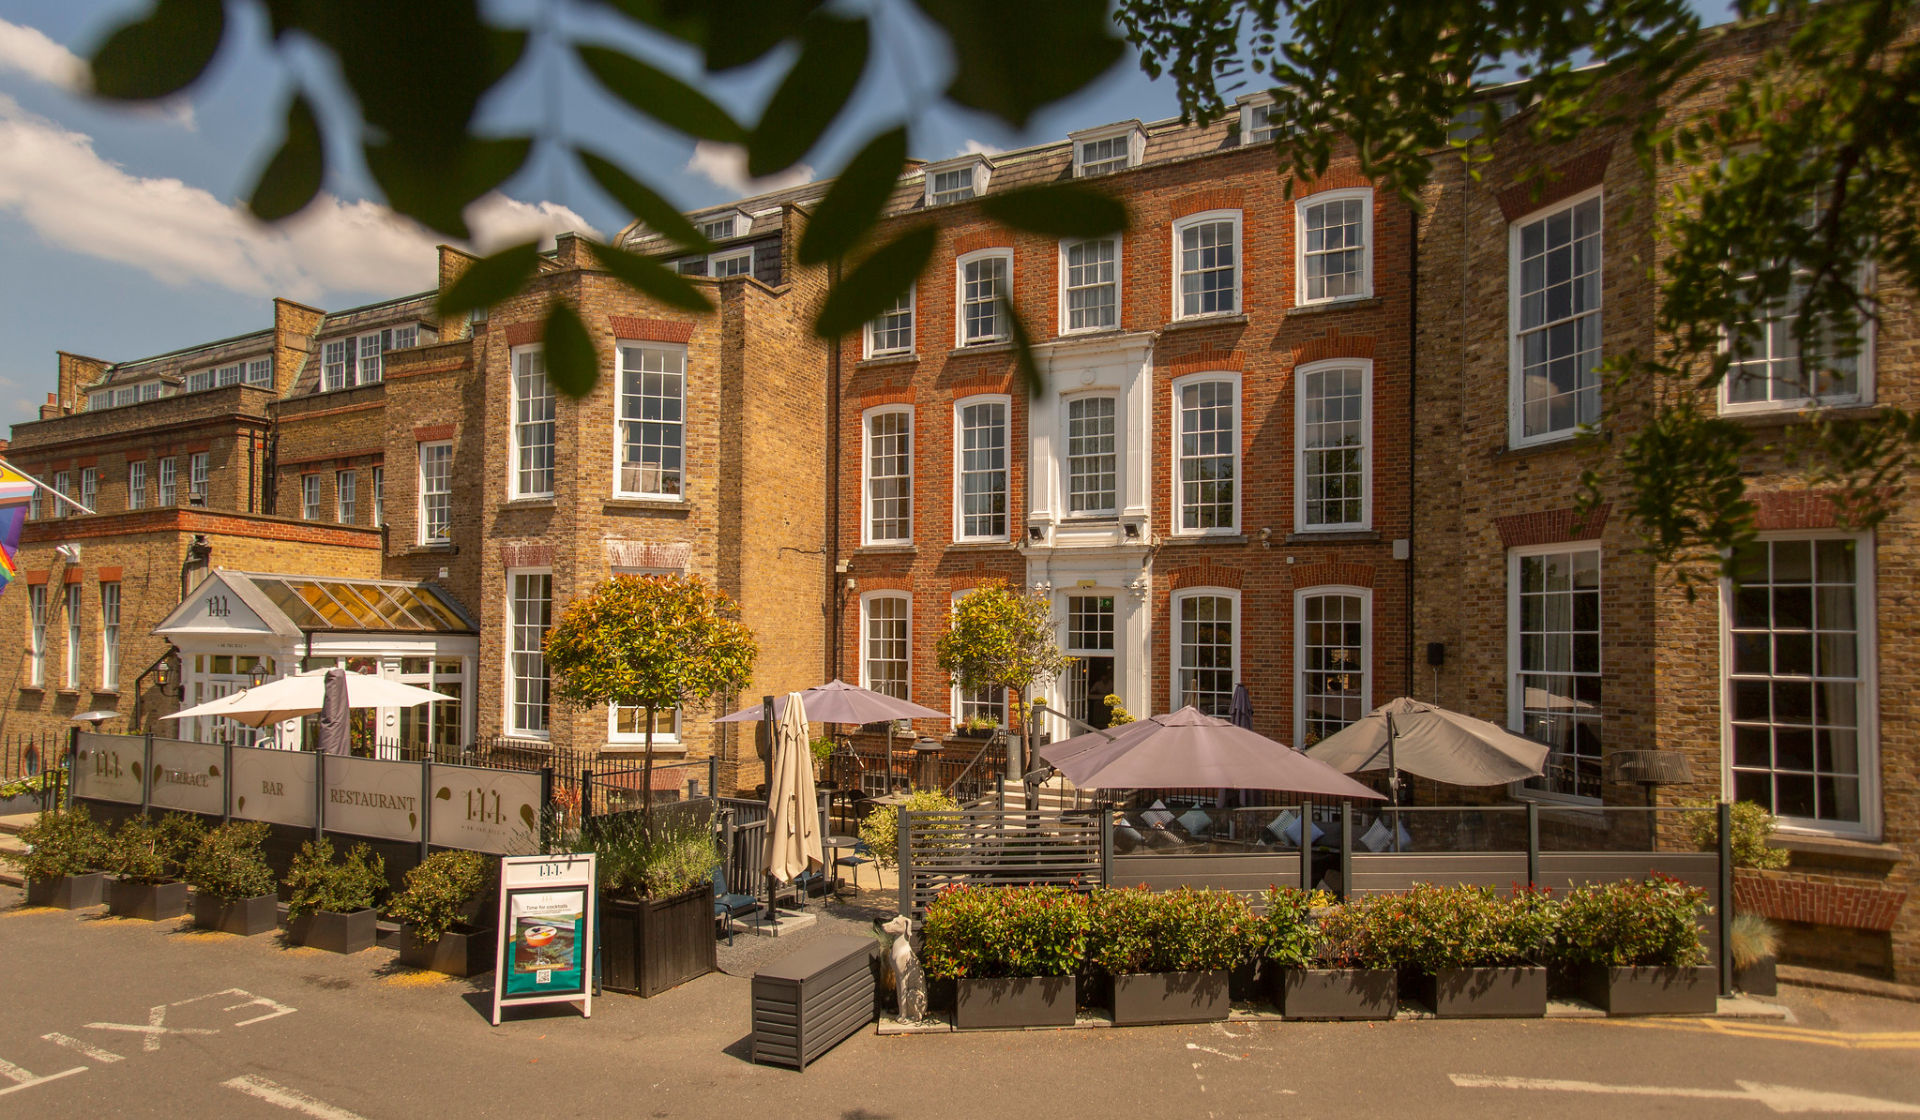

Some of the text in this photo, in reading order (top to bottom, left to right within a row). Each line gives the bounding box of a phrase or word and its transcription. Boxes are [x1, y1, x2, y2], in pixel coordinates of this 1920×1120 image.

[165, 770, 209, 788] TERRACE
[262, 780, 284, 796] BAR
[330, 788, 416, 811] RESTAURANT
